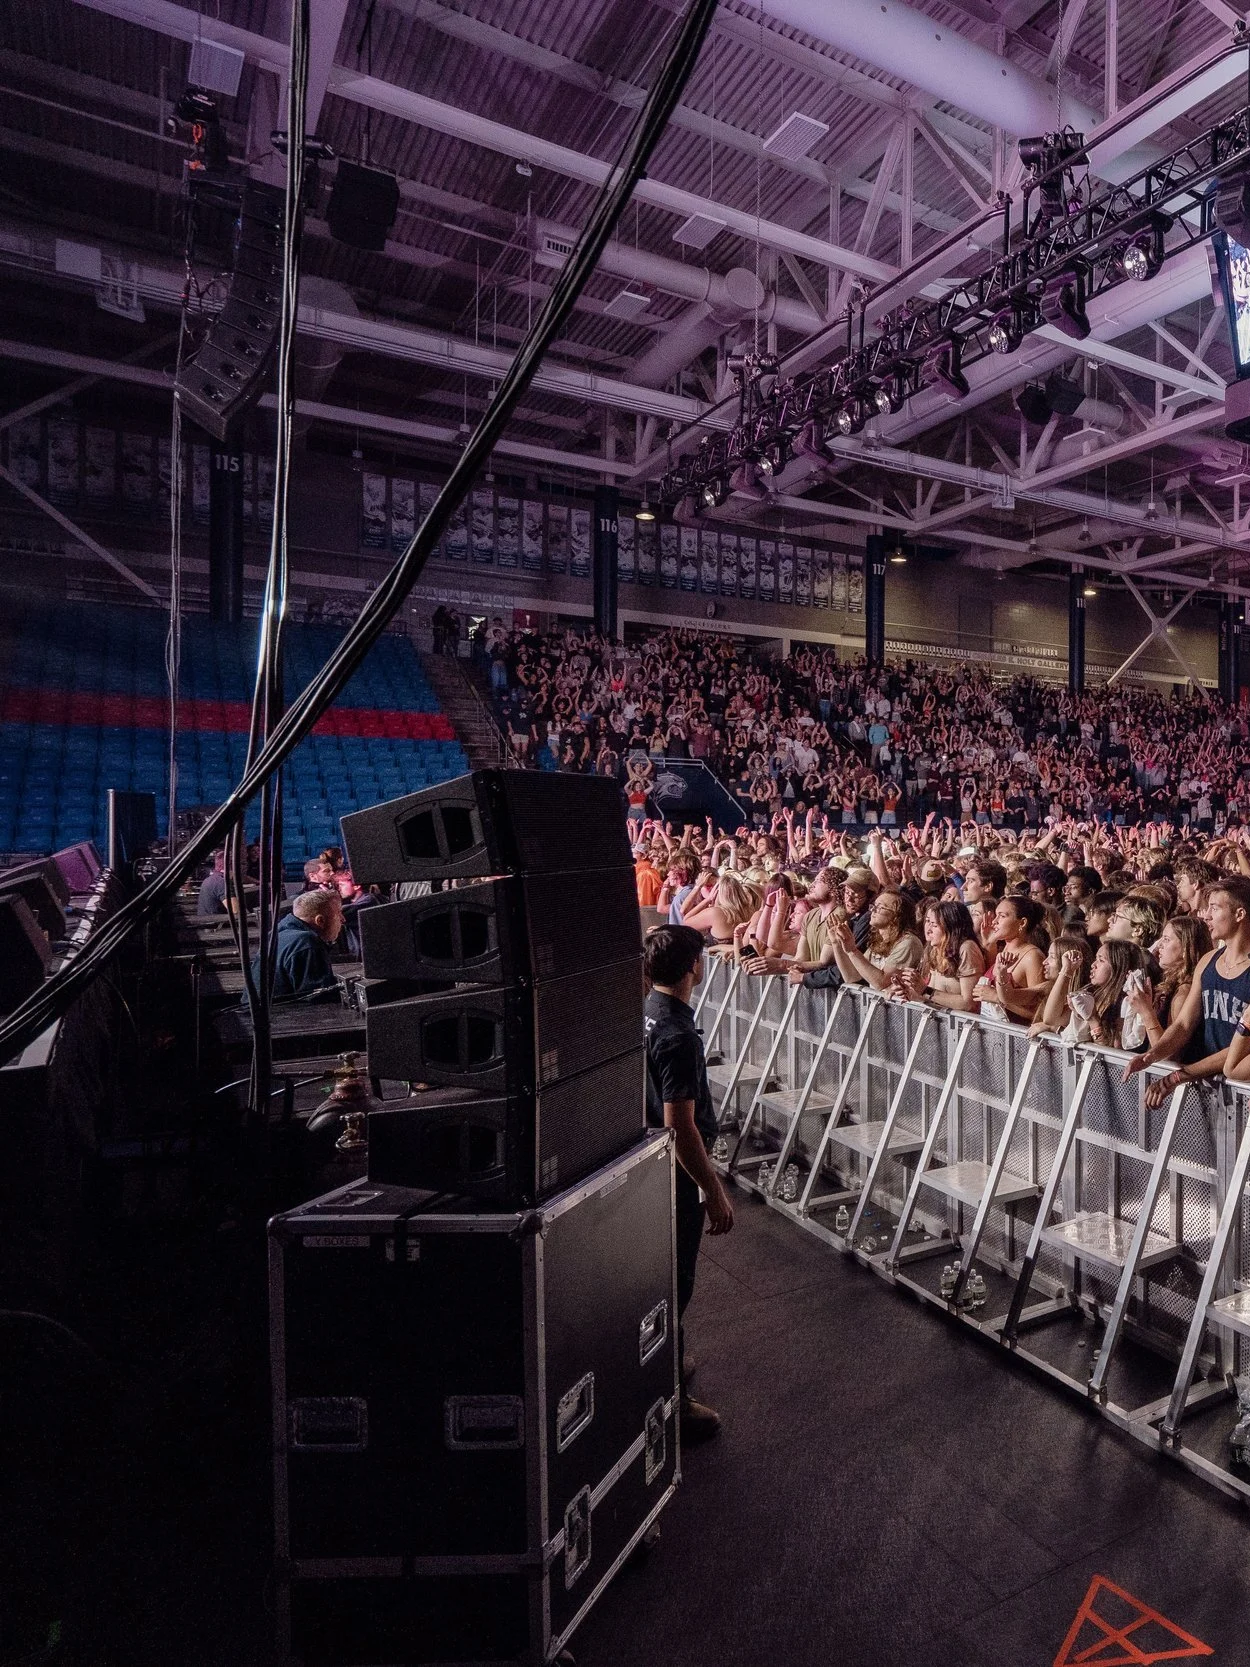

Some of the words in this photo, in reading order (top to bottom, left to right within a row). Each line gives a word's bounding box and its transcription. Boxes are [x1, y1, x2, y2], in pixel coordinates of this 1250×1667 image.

[215, 454, 240, 472] 115
[600, 518, 618, 533] 116
[872, 563, 886, 576] 117
[1037, 660, 1069, 670] GALLERY
